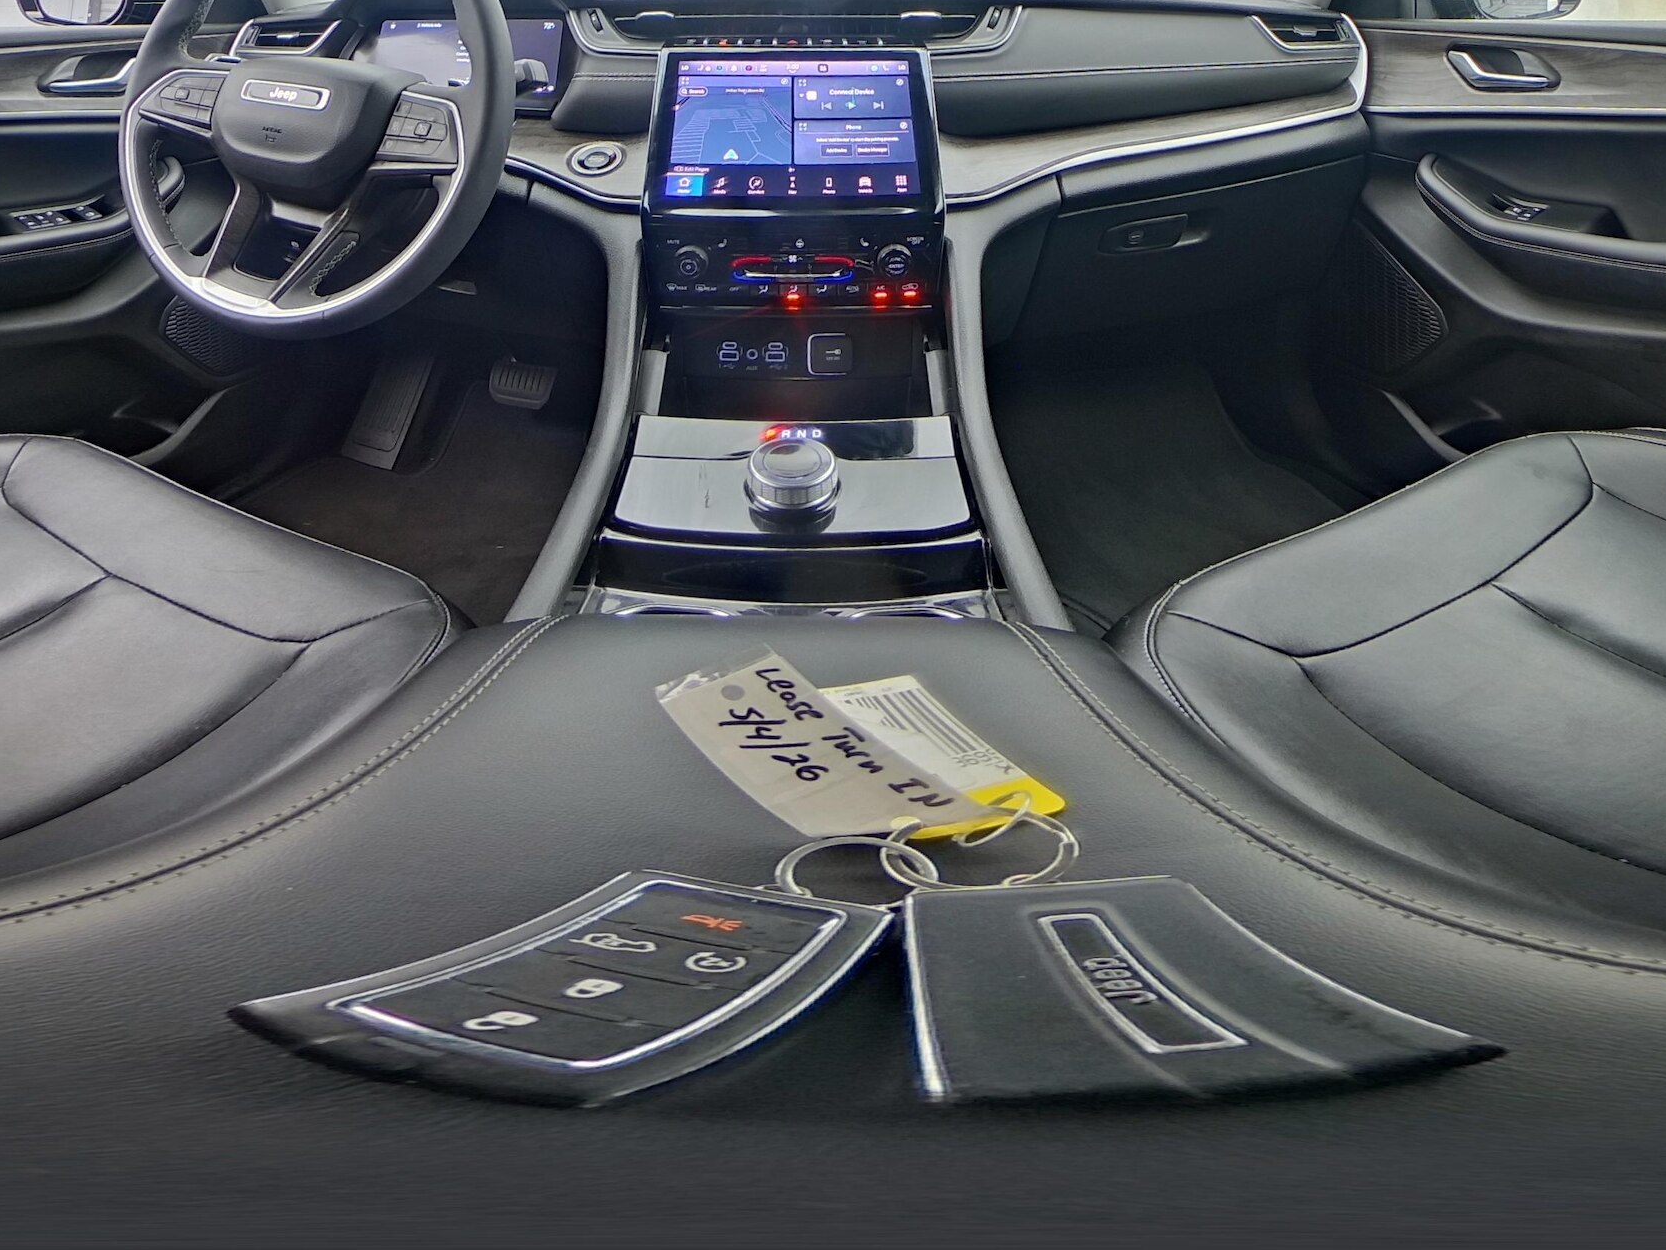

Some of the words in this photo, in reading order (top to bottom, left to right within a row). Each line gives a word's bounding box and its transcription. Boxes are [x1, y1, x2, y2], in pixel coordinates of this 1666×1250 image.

[269, 86, 298, 102] Jeep
[766, 429, 776, 438] P
[781, 429, 791, 438] R
[797, 429, 807, 438] N
[812, 429, 821, 438] D
[718, 707, 829, 781] 5/4/26
[821, 726, 884, 774] Turn
[887, 777, 955, 809] IN
[1082, 956, 1158, 1004] Jeep
